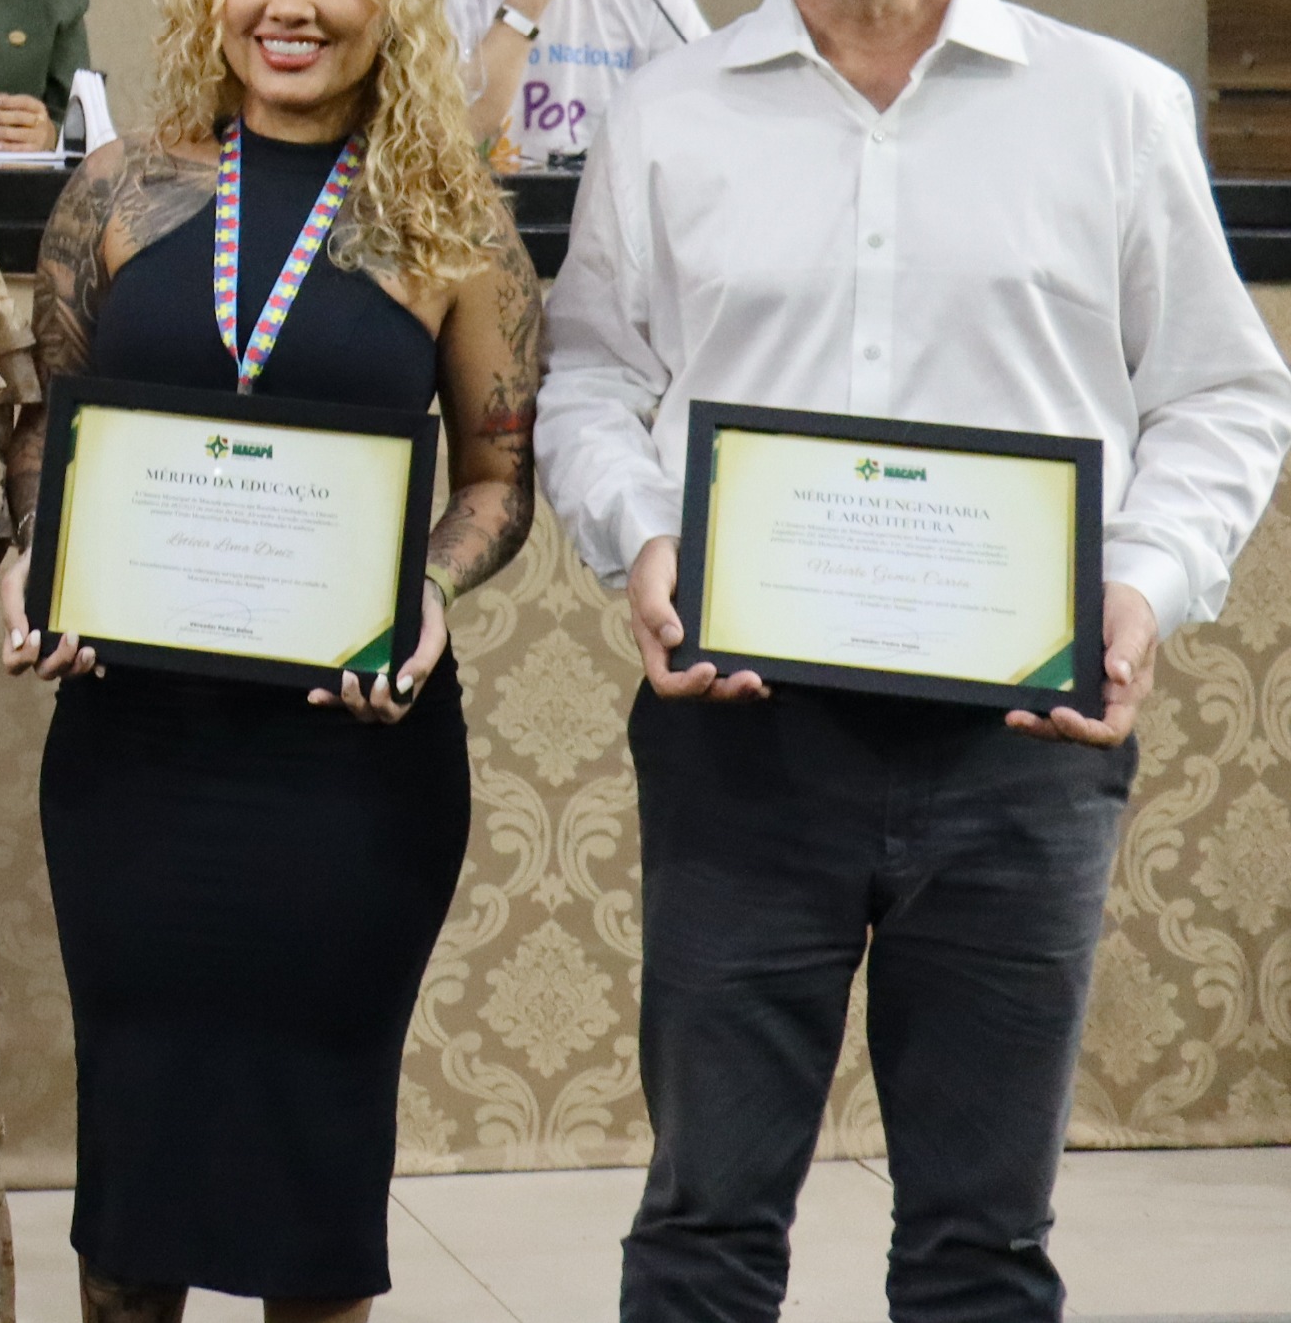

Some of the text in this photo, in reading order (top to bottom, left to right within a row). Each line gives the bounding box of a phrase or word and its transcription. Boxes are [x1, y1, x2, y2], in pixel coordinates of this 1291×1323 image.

[548, 43, 634, 70] Nacional
[145, 466, 330, 503] MÉRITO DA EDUCAÇÃO
[792, 488, 991, 521] MÉRITO EM ENGENHARIA
[827, 510, 955, 535] E ARQUITETURA
